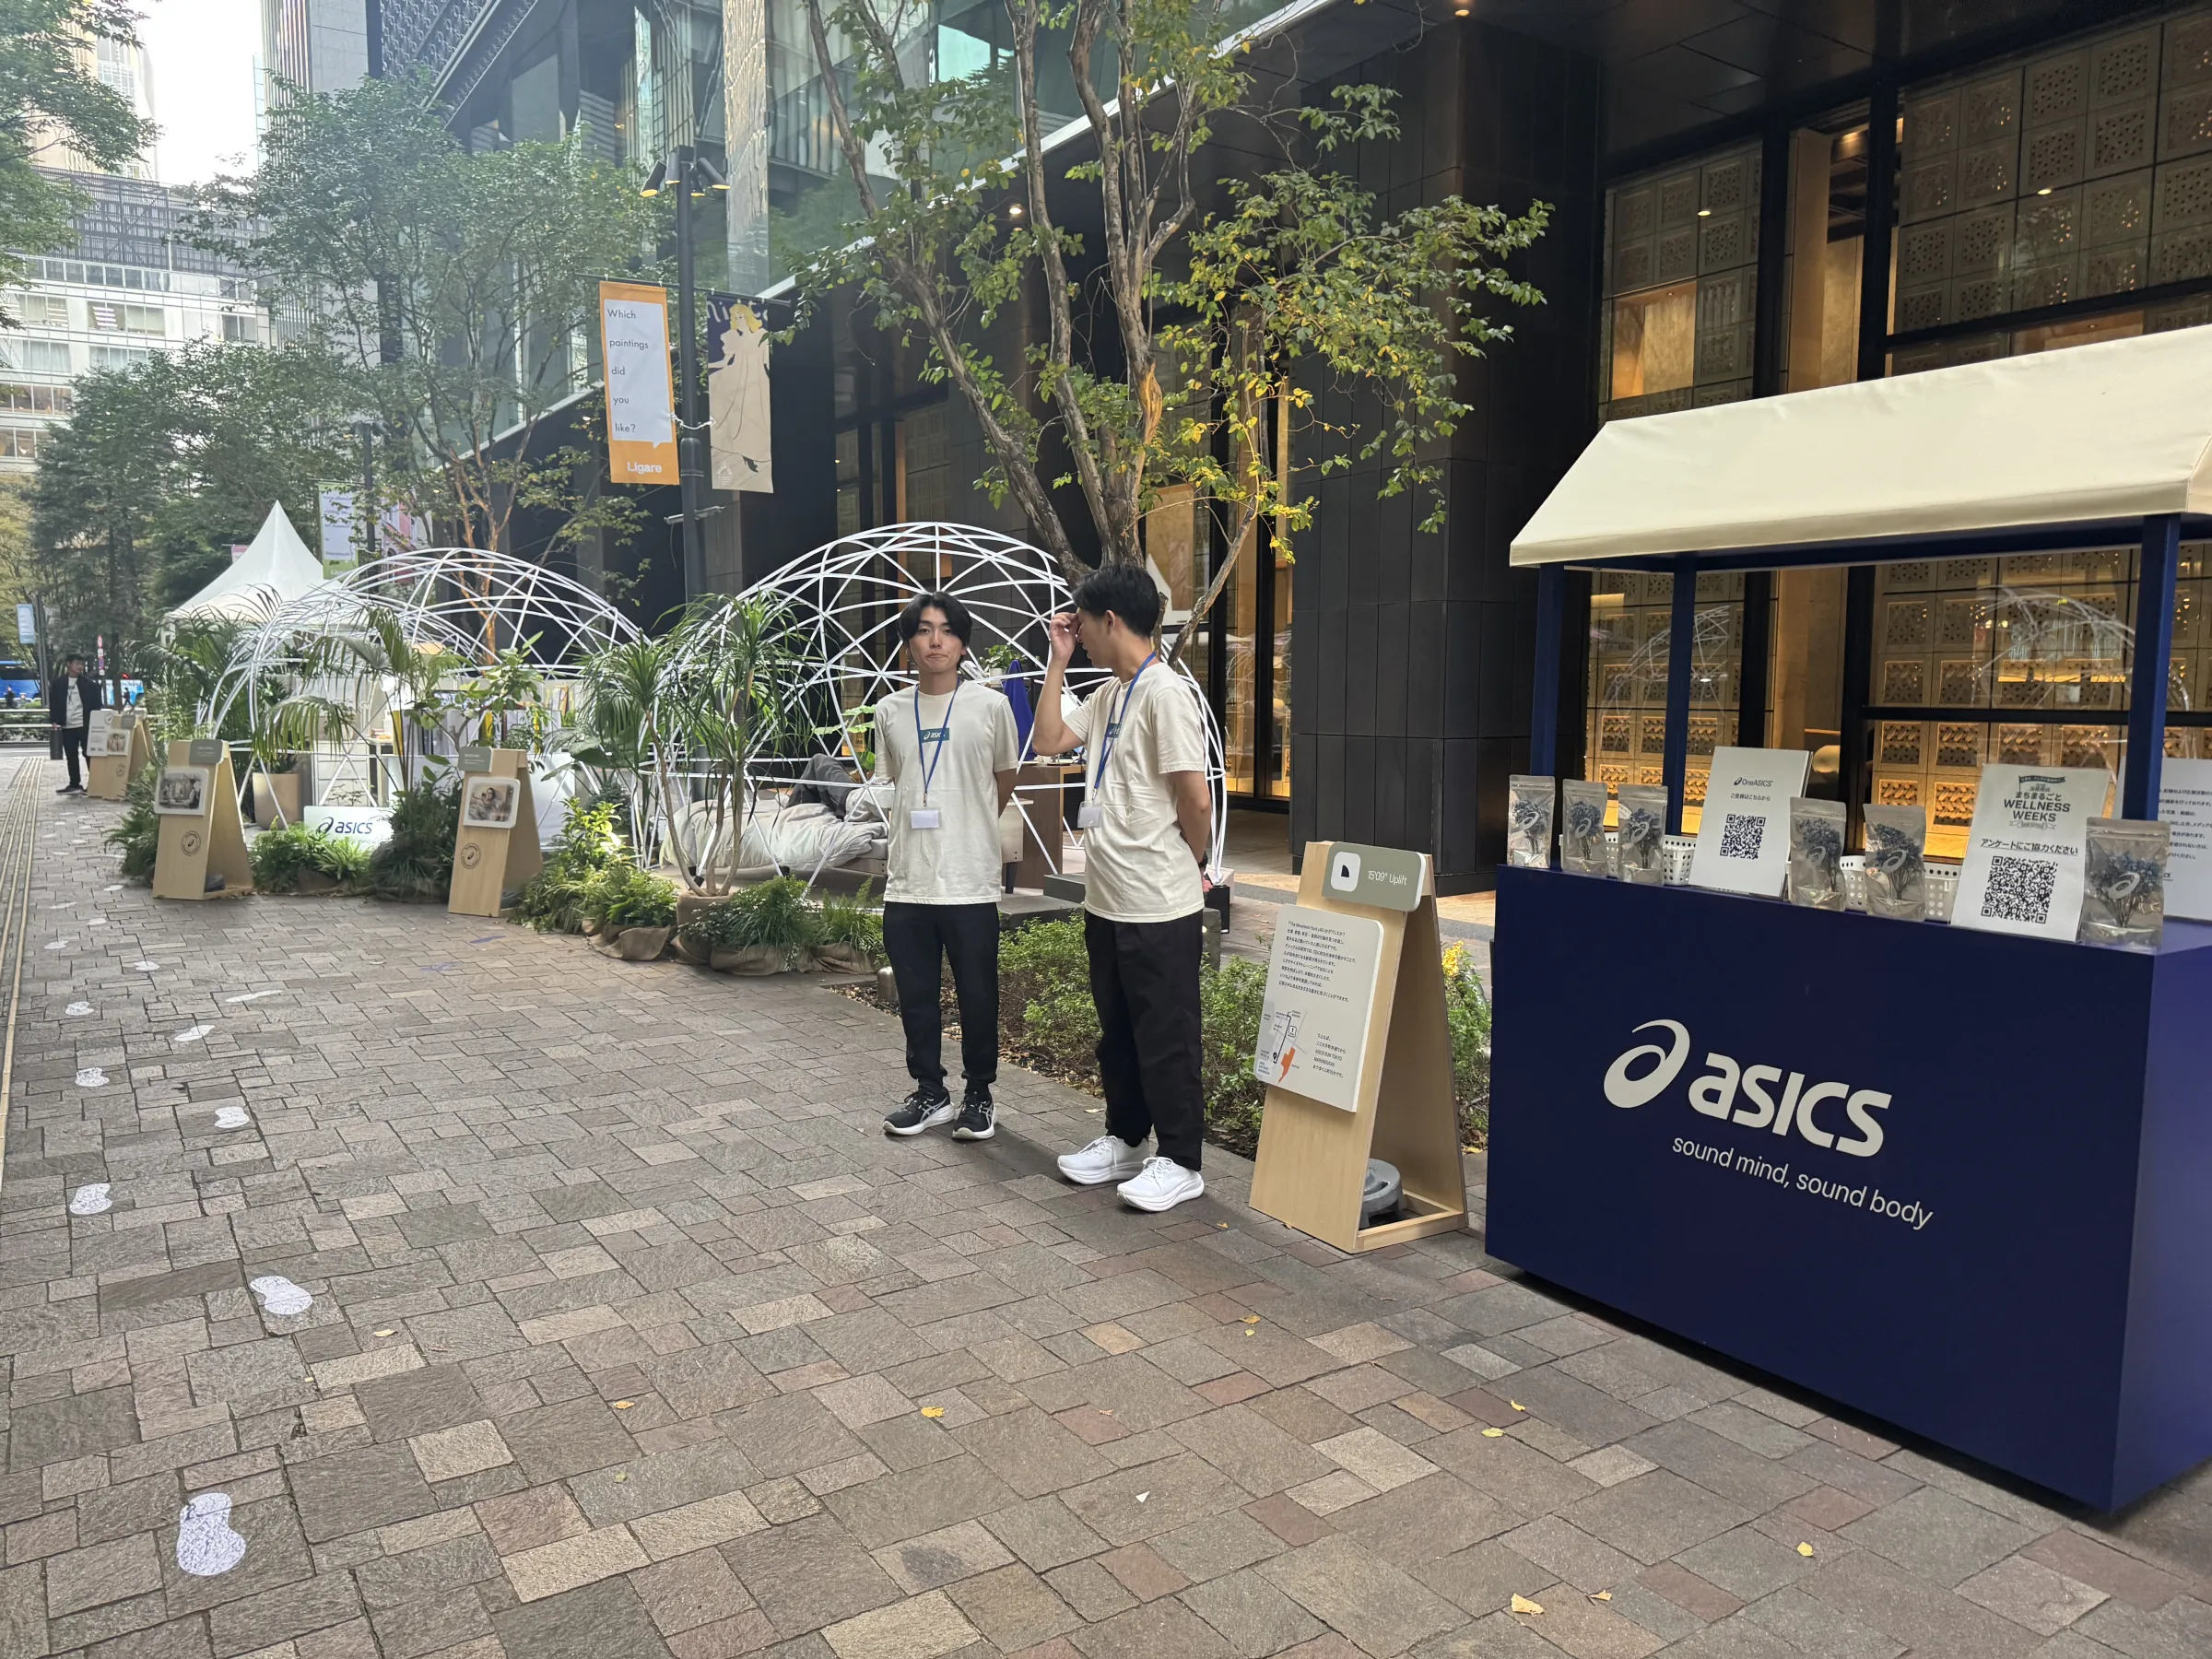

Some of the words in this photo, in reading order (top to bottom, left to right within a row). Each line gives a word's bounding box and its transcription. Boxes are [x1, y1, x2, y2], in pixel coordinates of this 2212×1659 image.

[606, 308, 637, 320] Which
[609, 338, 649, 350] paintings
[611, 366, 626, 376] did
[613, 396, 629, 406] you
[615, 423, 636, 433] like?
[627, 462, 663, 474] Ligare
[2016, 792, 2062, 802] まちまるごと
[2004, 799, 2071, 813] WELLNESS
[2013, 810, 2057, 822] WEEKS
[1980, 838, 2079, 854] アンケートにご協力ください
[1389, 873, 1407, 886] Uplift
[1672, 1136, 1735, 1168] sound
[1735, 1155, 1790, 1188] mind,
[1795, 1172, 1868, 1207] sound
[1869, 1189, 1934, 1230] body
